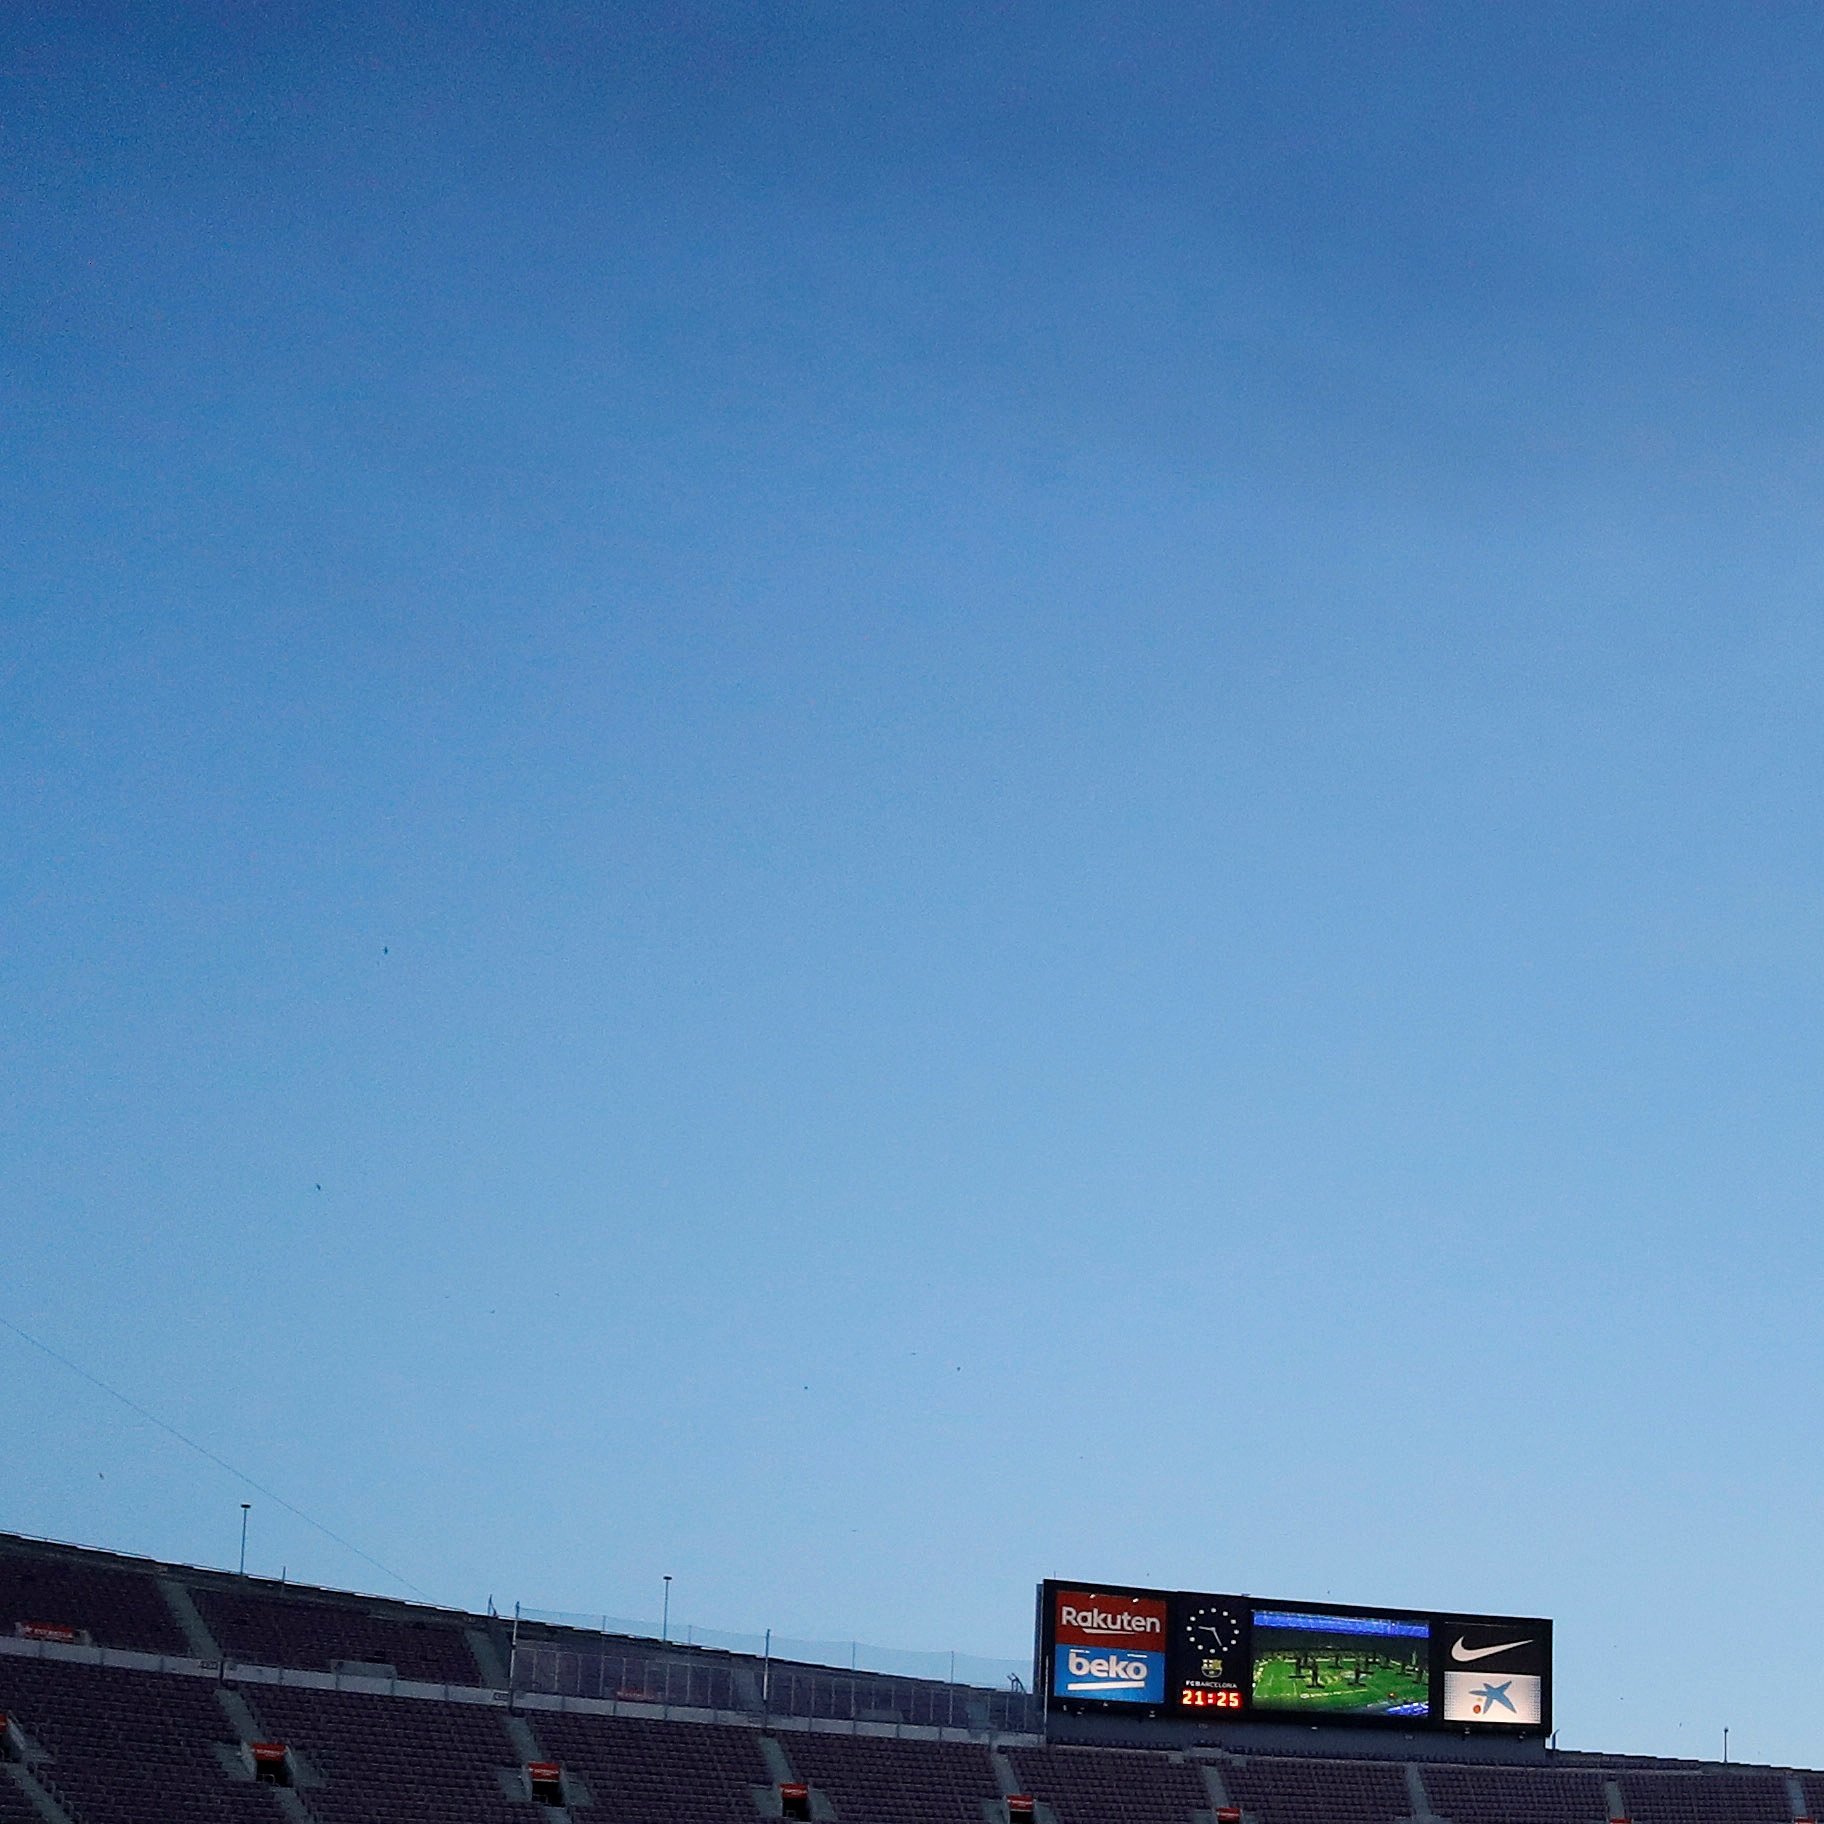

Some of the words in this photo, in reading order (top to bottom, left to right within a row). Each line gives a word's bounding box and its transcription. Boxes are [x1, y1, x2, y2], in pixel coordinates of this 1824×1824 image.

[1061, 1606, 1160, 1633] Rakuten
[1068, 1652, 1148, 1680] beko
[1182, 1690, 1240, 1707] 21:25
